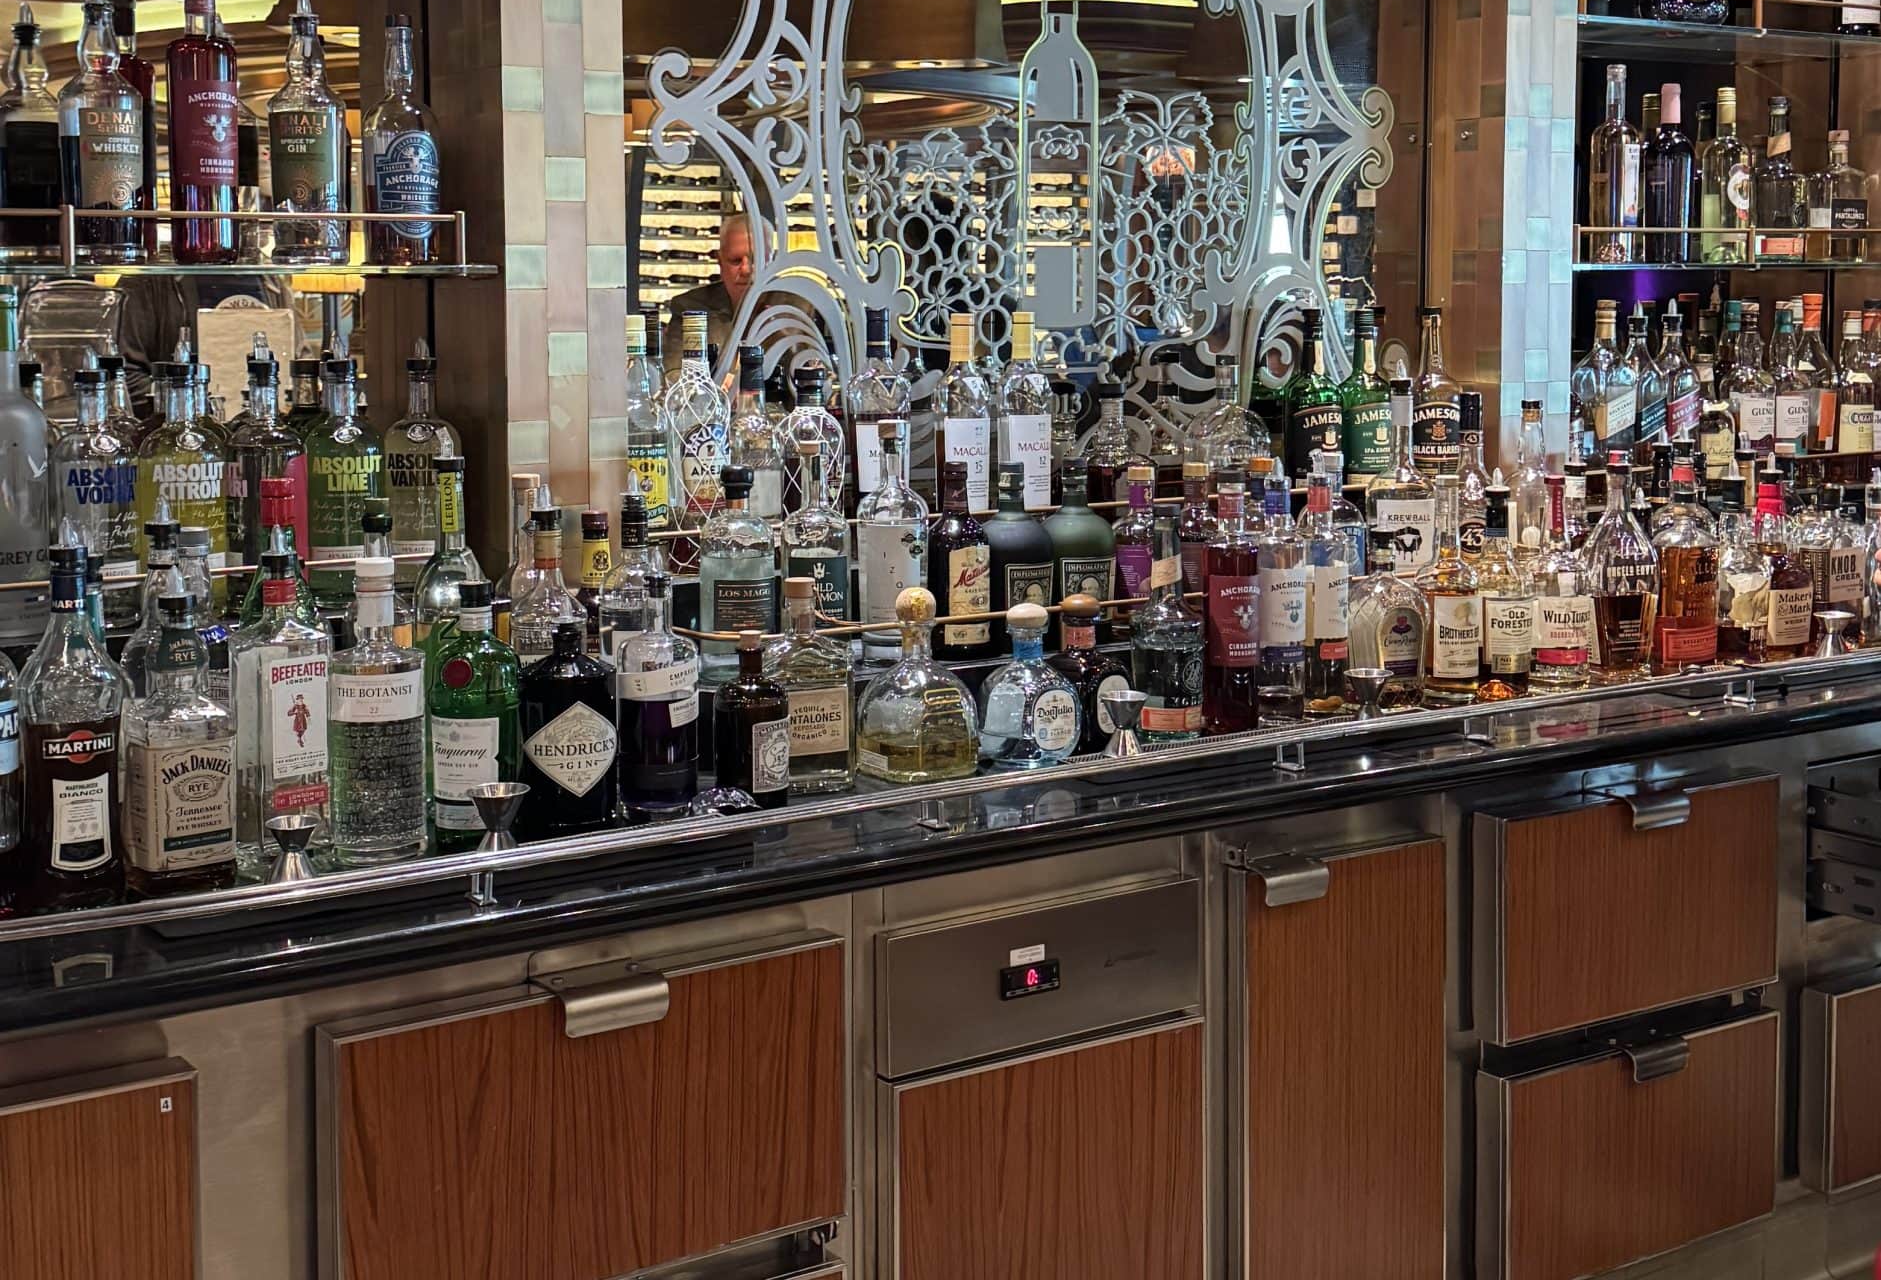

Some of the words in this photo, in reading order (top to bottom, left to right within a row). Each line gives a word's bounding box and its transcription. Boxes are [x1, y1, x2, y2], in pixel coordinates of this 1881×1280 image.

[92, 143, 139, 154] WHISKEY
[287, 144, 307, 153] GIN
[312, 455, 382, 473] ABSOLUT
[388, 453, 435, 470] ABSOL
[1039, 456, 1047, 465] 12
[153, 462, 224, 482] ABSOLUT
[327, 473, 369, 491] LIME
[160, 480, 220, 500] CITRON
[444, 476, 455, 527] LEBLON
[1461, 528, 1485, 546] 43
[1831, 555, 1857, 575] KNOB
[719, 589, 740, 598] LOS
[1508, 610, 1525, 619] OLD
[1543, 610, 1570, 624] WILD
[175, 651, 197, 662] RYE
[271, 661, 326, 684] BEEFEATER
[285, 677, 313, 686] LONDON
[336, 687, 356, 698] THE
[358, 684, 412, 698] BOTANIST
[790, 711, 842, 725] NTALONES
[48, 736, 111, 755] MARTINI
[433, 741, 487, 760] Tanqueray
[161, 760, 189, 784] JACK
[566, 760, 593, 770] GIN
[188, 782, 210, 793] RYE
